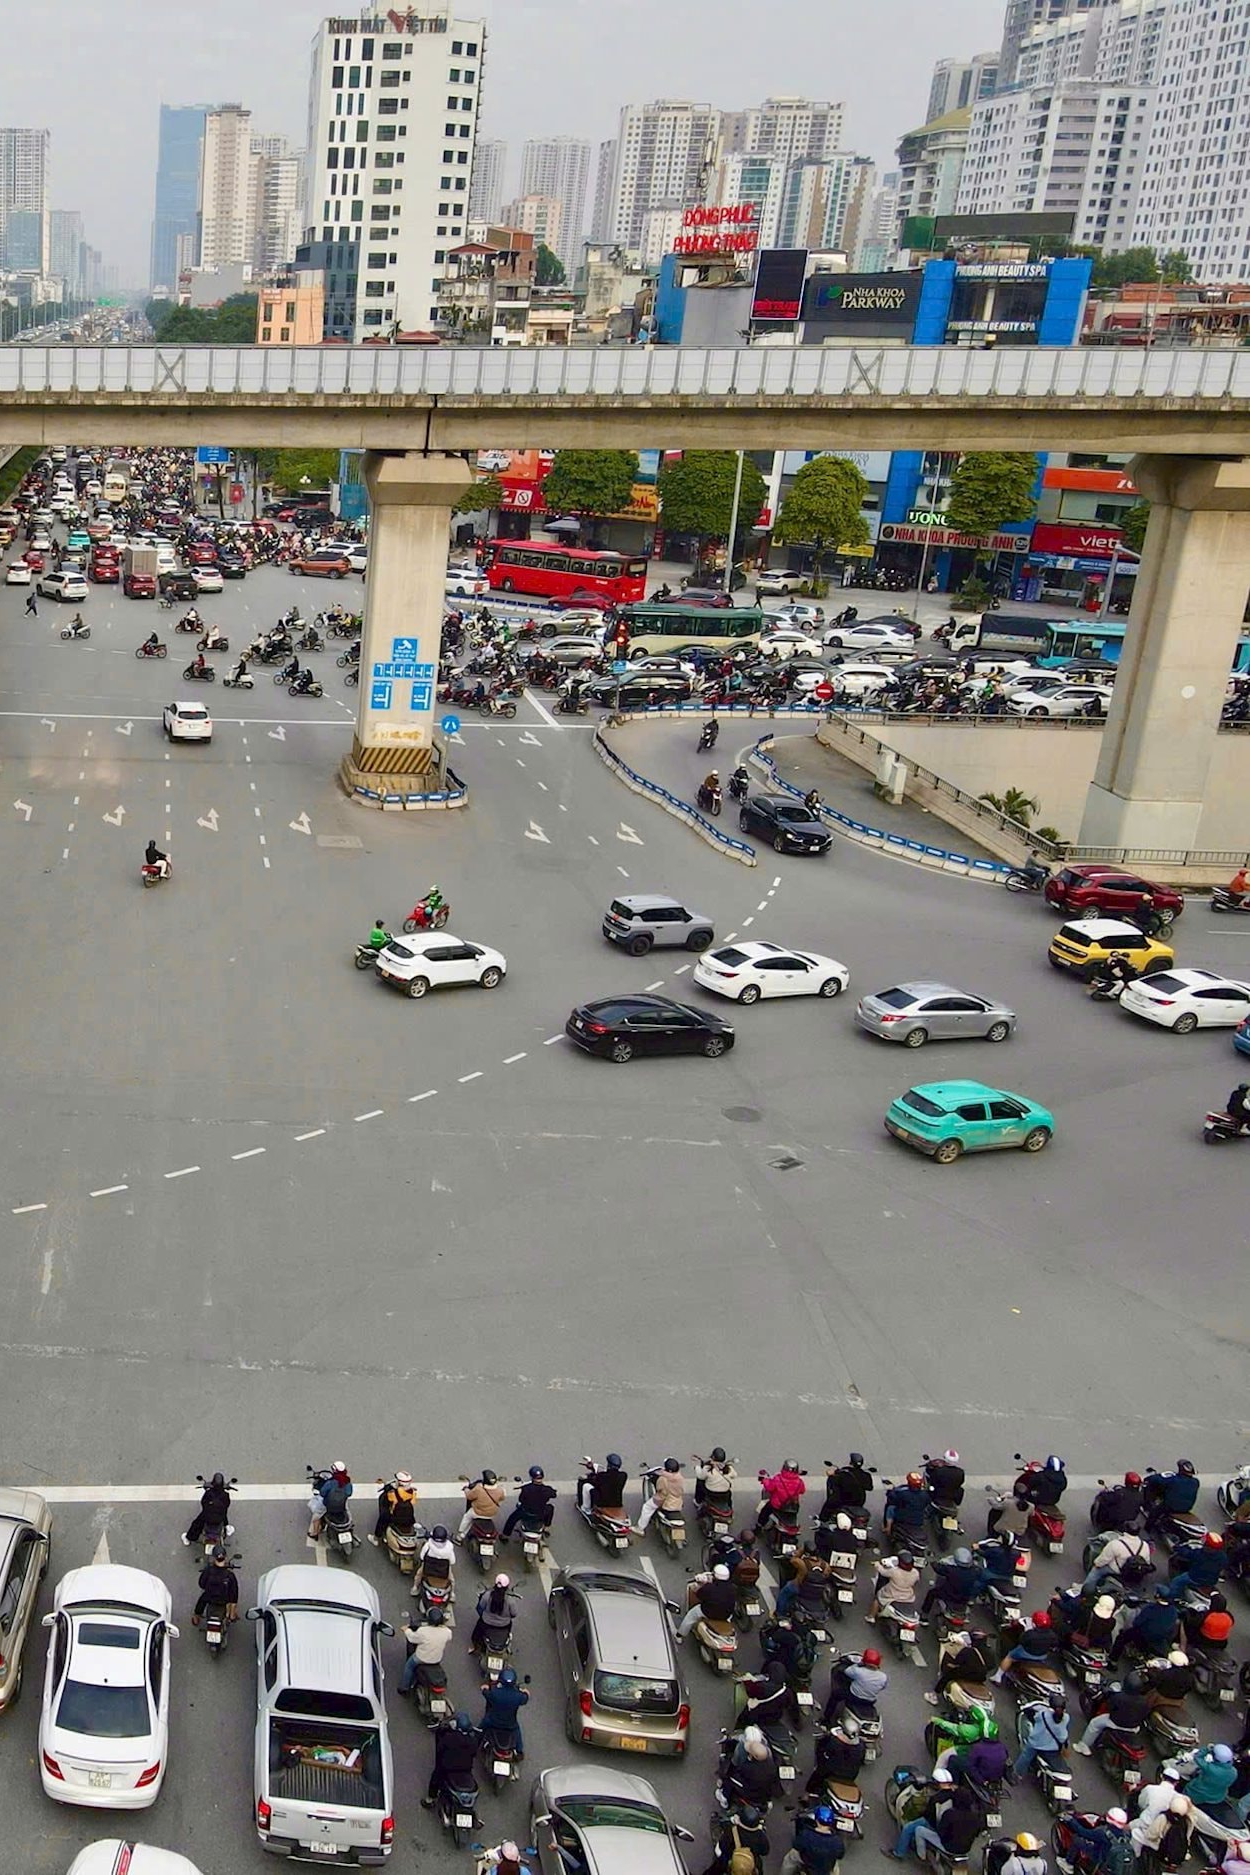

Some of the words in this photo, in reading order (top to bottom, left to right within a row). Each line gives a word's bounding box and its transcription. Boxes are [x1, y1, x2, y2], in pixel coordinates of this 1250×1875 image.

[998, 265, 1029, 277] BEAUTY
[1029, 265, 1047, 277] SPA
[853, 287, 876, 298] NHA
[877, 287, 906, 298] KHOA
[841, 291, 906, 309] PARKWAY
[989, 321, 1020, 331] BEAUTY
[1020, 322, 1036, 332] SPA
[894, 527, 915, 541] NHA
[918, 529, 944, 544] KHOA
[991, 535, 1014, 549] ANH
[1080, 535, 1120, 549] viet
